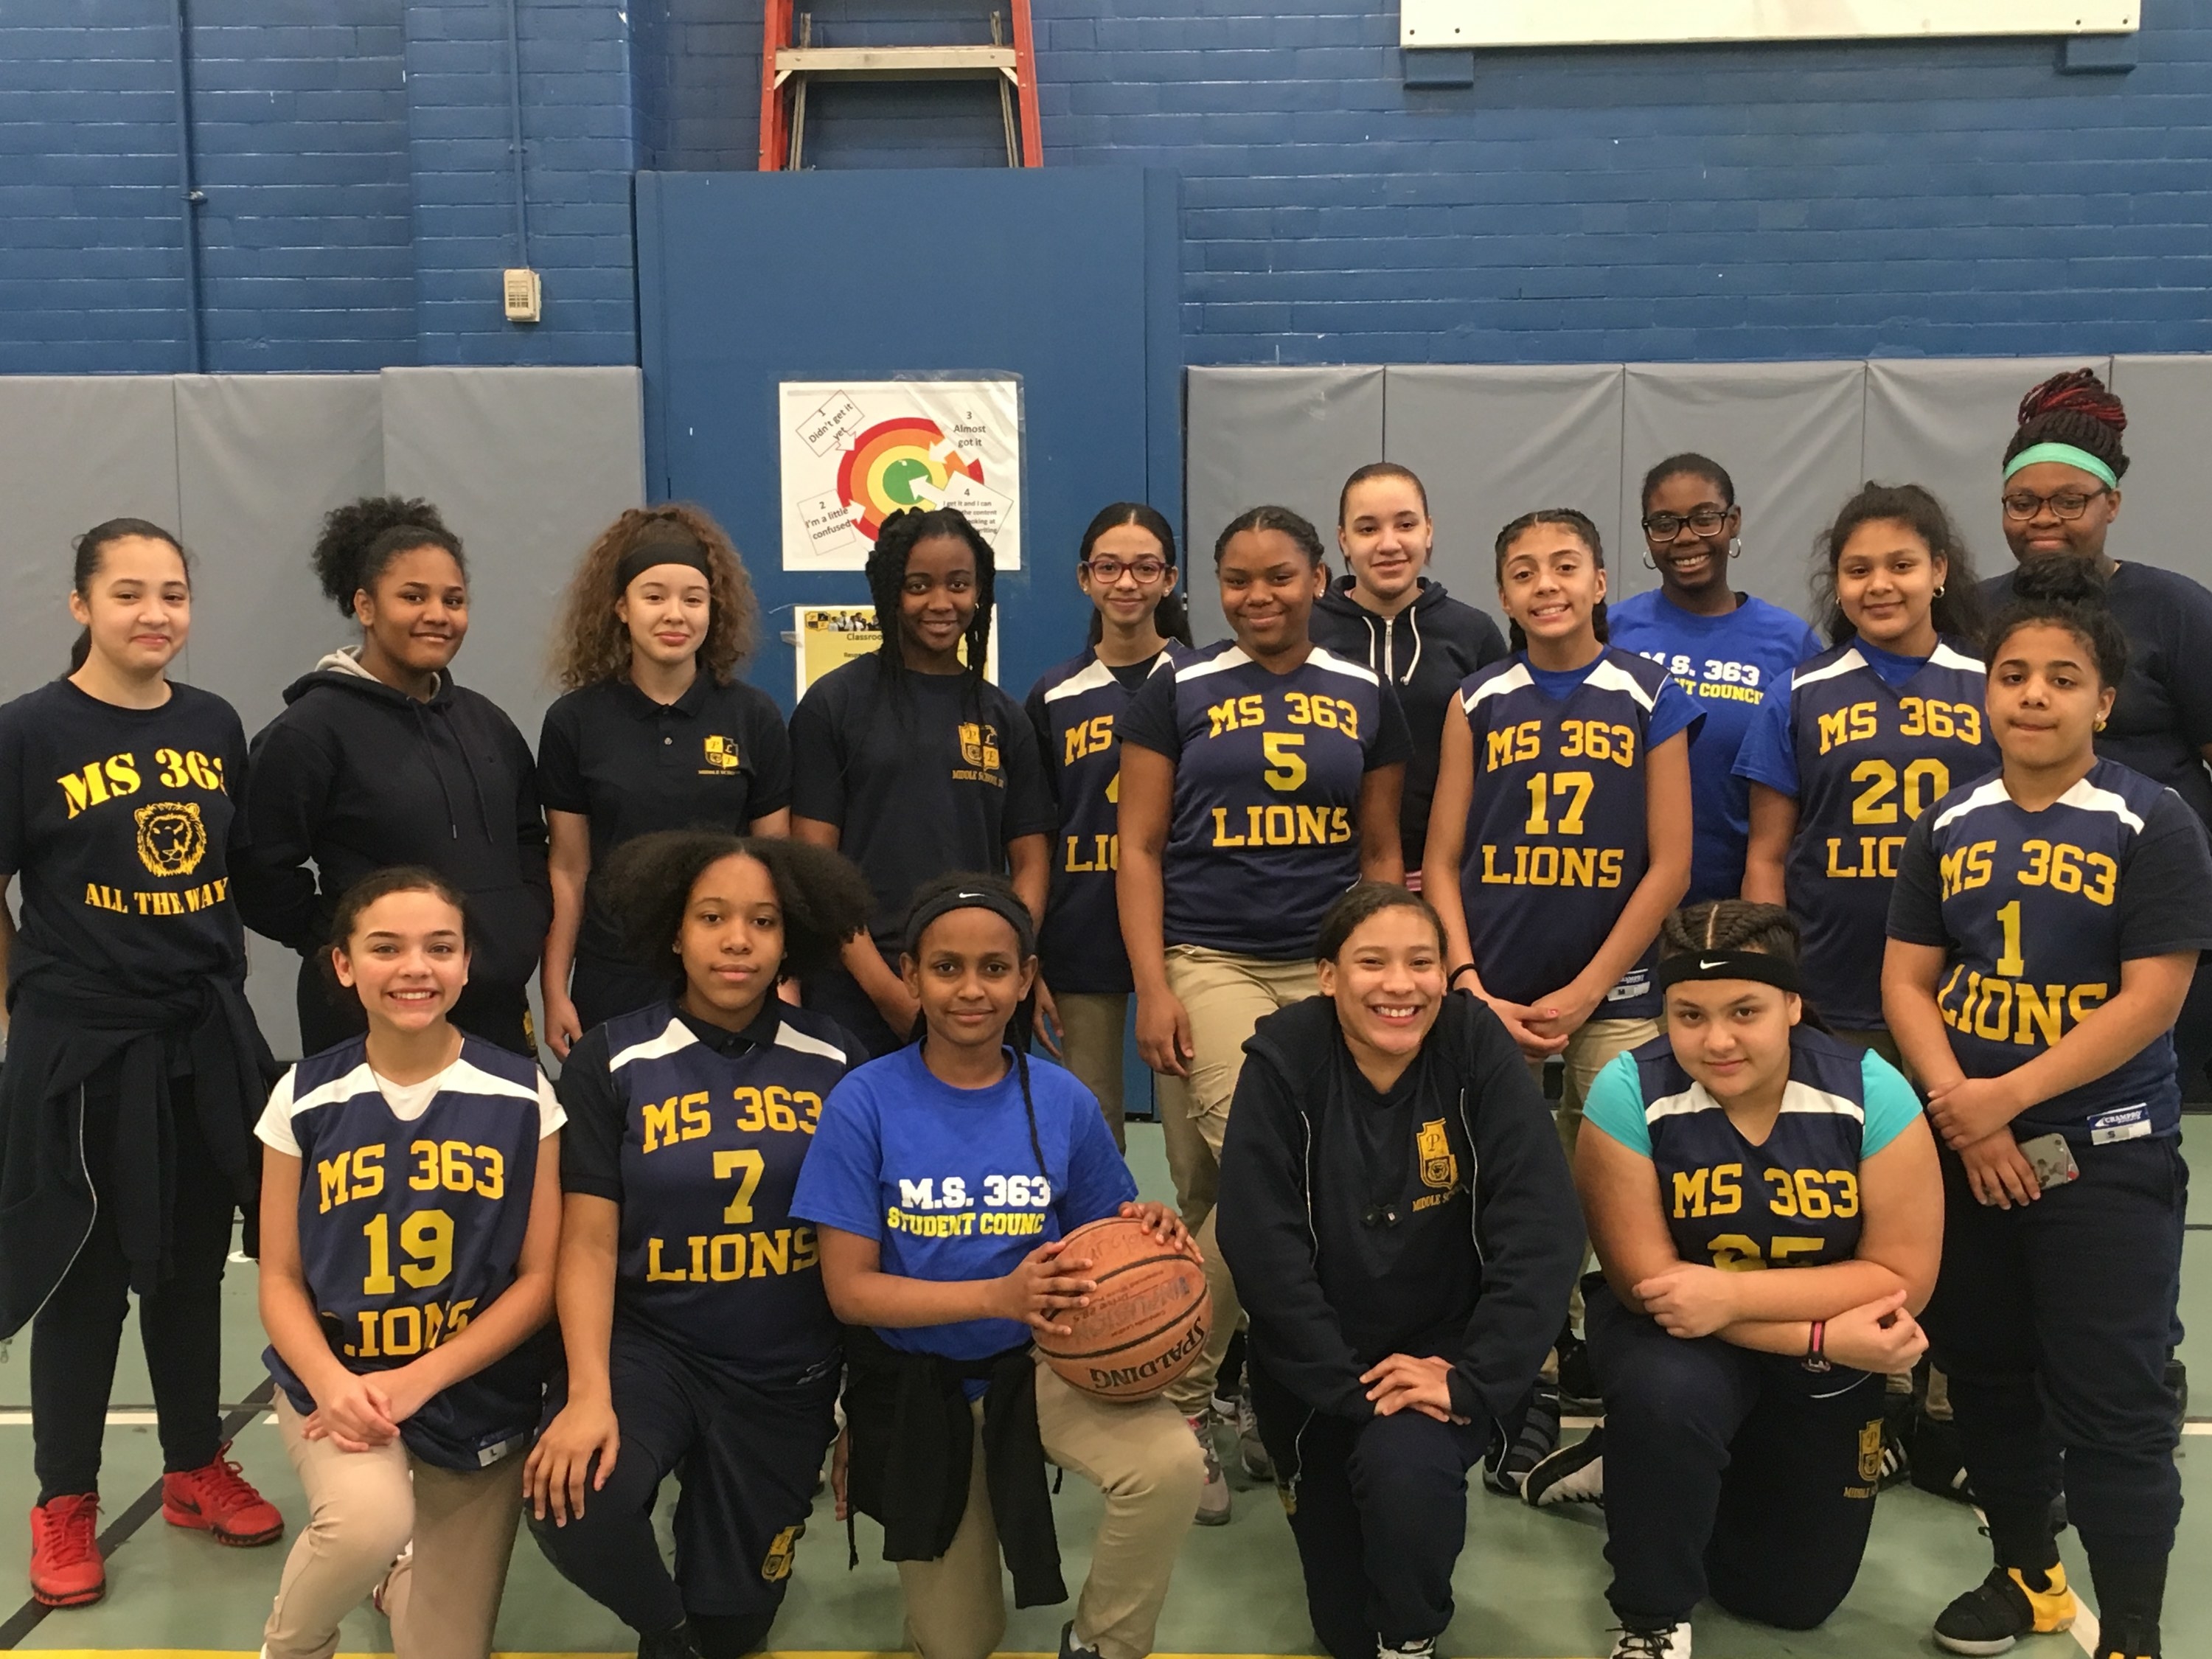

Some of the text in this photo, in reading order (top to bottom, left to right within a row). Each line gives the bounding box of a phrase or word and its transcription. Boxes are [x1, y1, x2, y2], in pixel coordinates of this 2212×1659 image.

[808, 403, 853, 443] Didn't get it
[818, 408, 826, 417] 1
[832, 427, 848, 441] yet
[953, 424, 986, 433] Almost
[967, 411, 973, 420] 3
[958, 438, 982, 448] got it
[819, 501, 826, 509] 2
[964, 488, 970, 496] 4
[805, 518, 820, 529] I'm
[827, 508, 849, 520] little
[813, 519, 852, 540] confused
[1703, 660, 1760, 686] 363
[1065, 714, 1113, 766] MS
[1207, 692, 1359, 740] MS 363
[1818, 697, 1981, 755] MS 363
[1262, 732, 1307, 791] 5
[1486, 720, 1635, 773] MS 363
[57, 748, 228, 819] MS 36
[1525, 771, 1594, 835] 17
[1851, 759, 1950, 824] 20
[1212, 805, 1351, 847] LIONS
[1482, 846, 1624, 888] LIONS
[1940, 840, 2118, 905] MS 363
[85, 877, 228, 915] ALL THE WAY
[1997, 900, 2024, 977] 1
[1937, 964, 2107, 1047] LIONS
[642, 1085, 823, 1154] MS 363
[318, 1140, 504, 1214] MS 363
[713, 1150, 765, 1224] 7
[899, 1175, 1051, 1209] M.S. 363
[1672, 1163, 1859, 1219] MS 363
[887, 1206, 975, 1238] STUDENT
[363, 1209, 455, 1295] 19
[647, 1227, 819, 1282] LIONS
[1089, 1315, 1205, 1389] SPALDING
